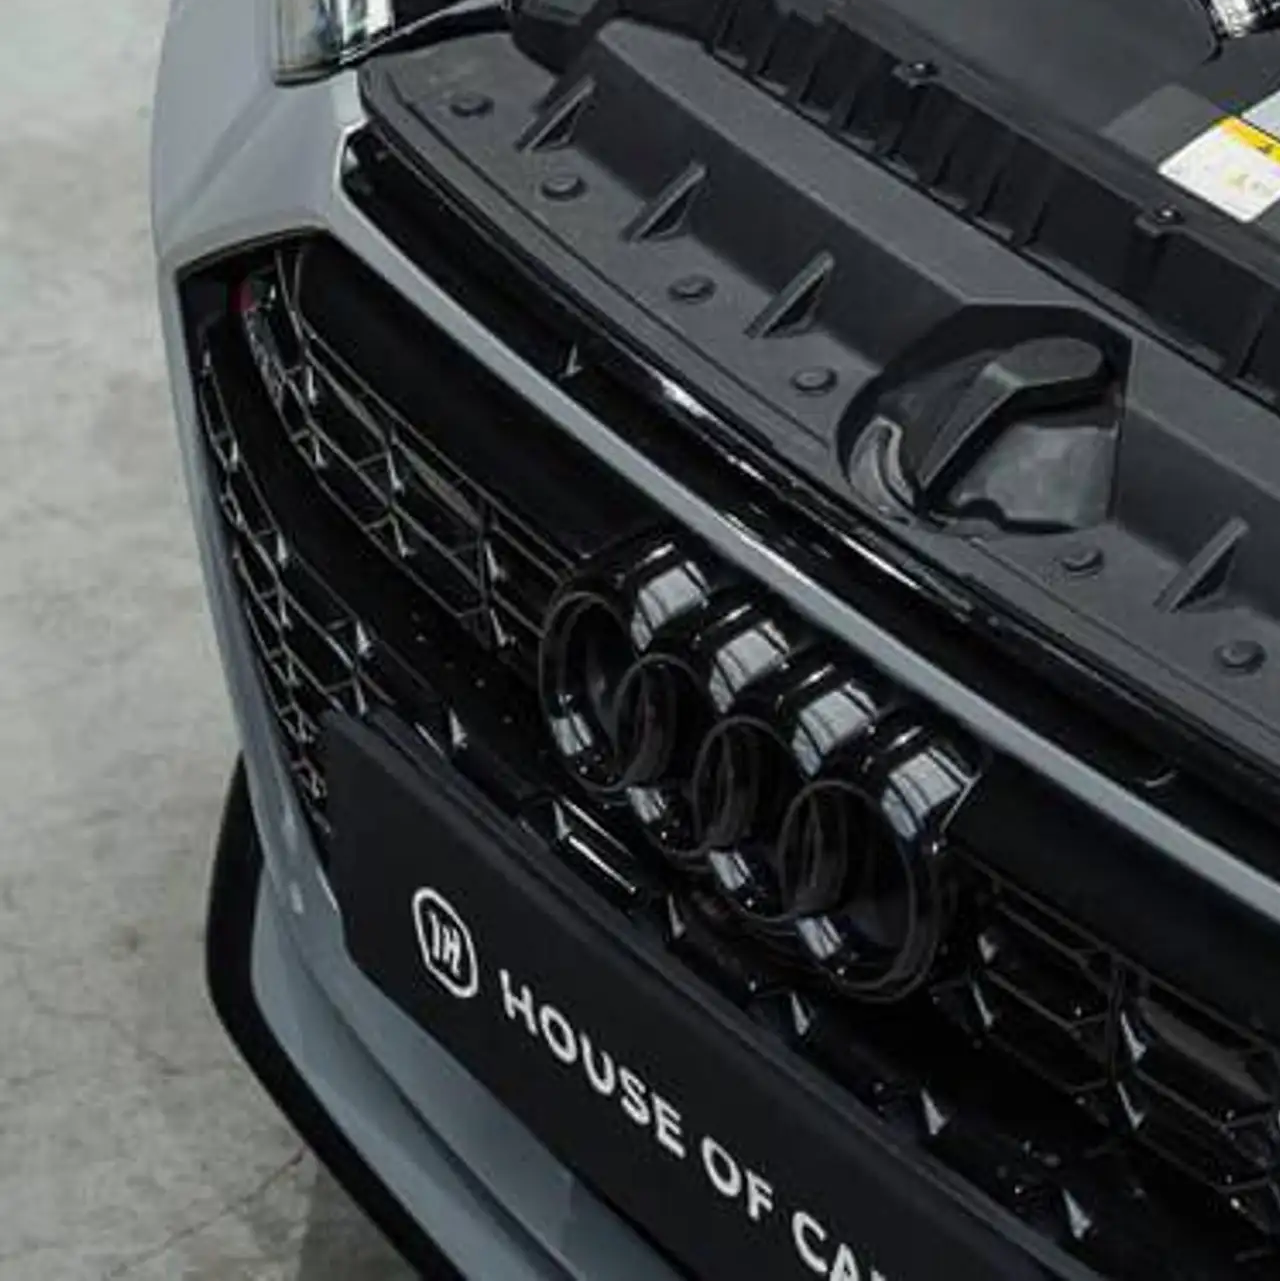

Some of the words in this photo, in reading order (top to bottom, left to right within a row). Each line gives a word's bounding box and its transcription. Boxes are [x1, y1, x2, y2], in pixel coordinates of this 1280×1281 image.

[500, 968, 687, 1159] HOUSE
[701, 1134, 775, 1221] OF
[791, 1209, 887, 1281] CA
